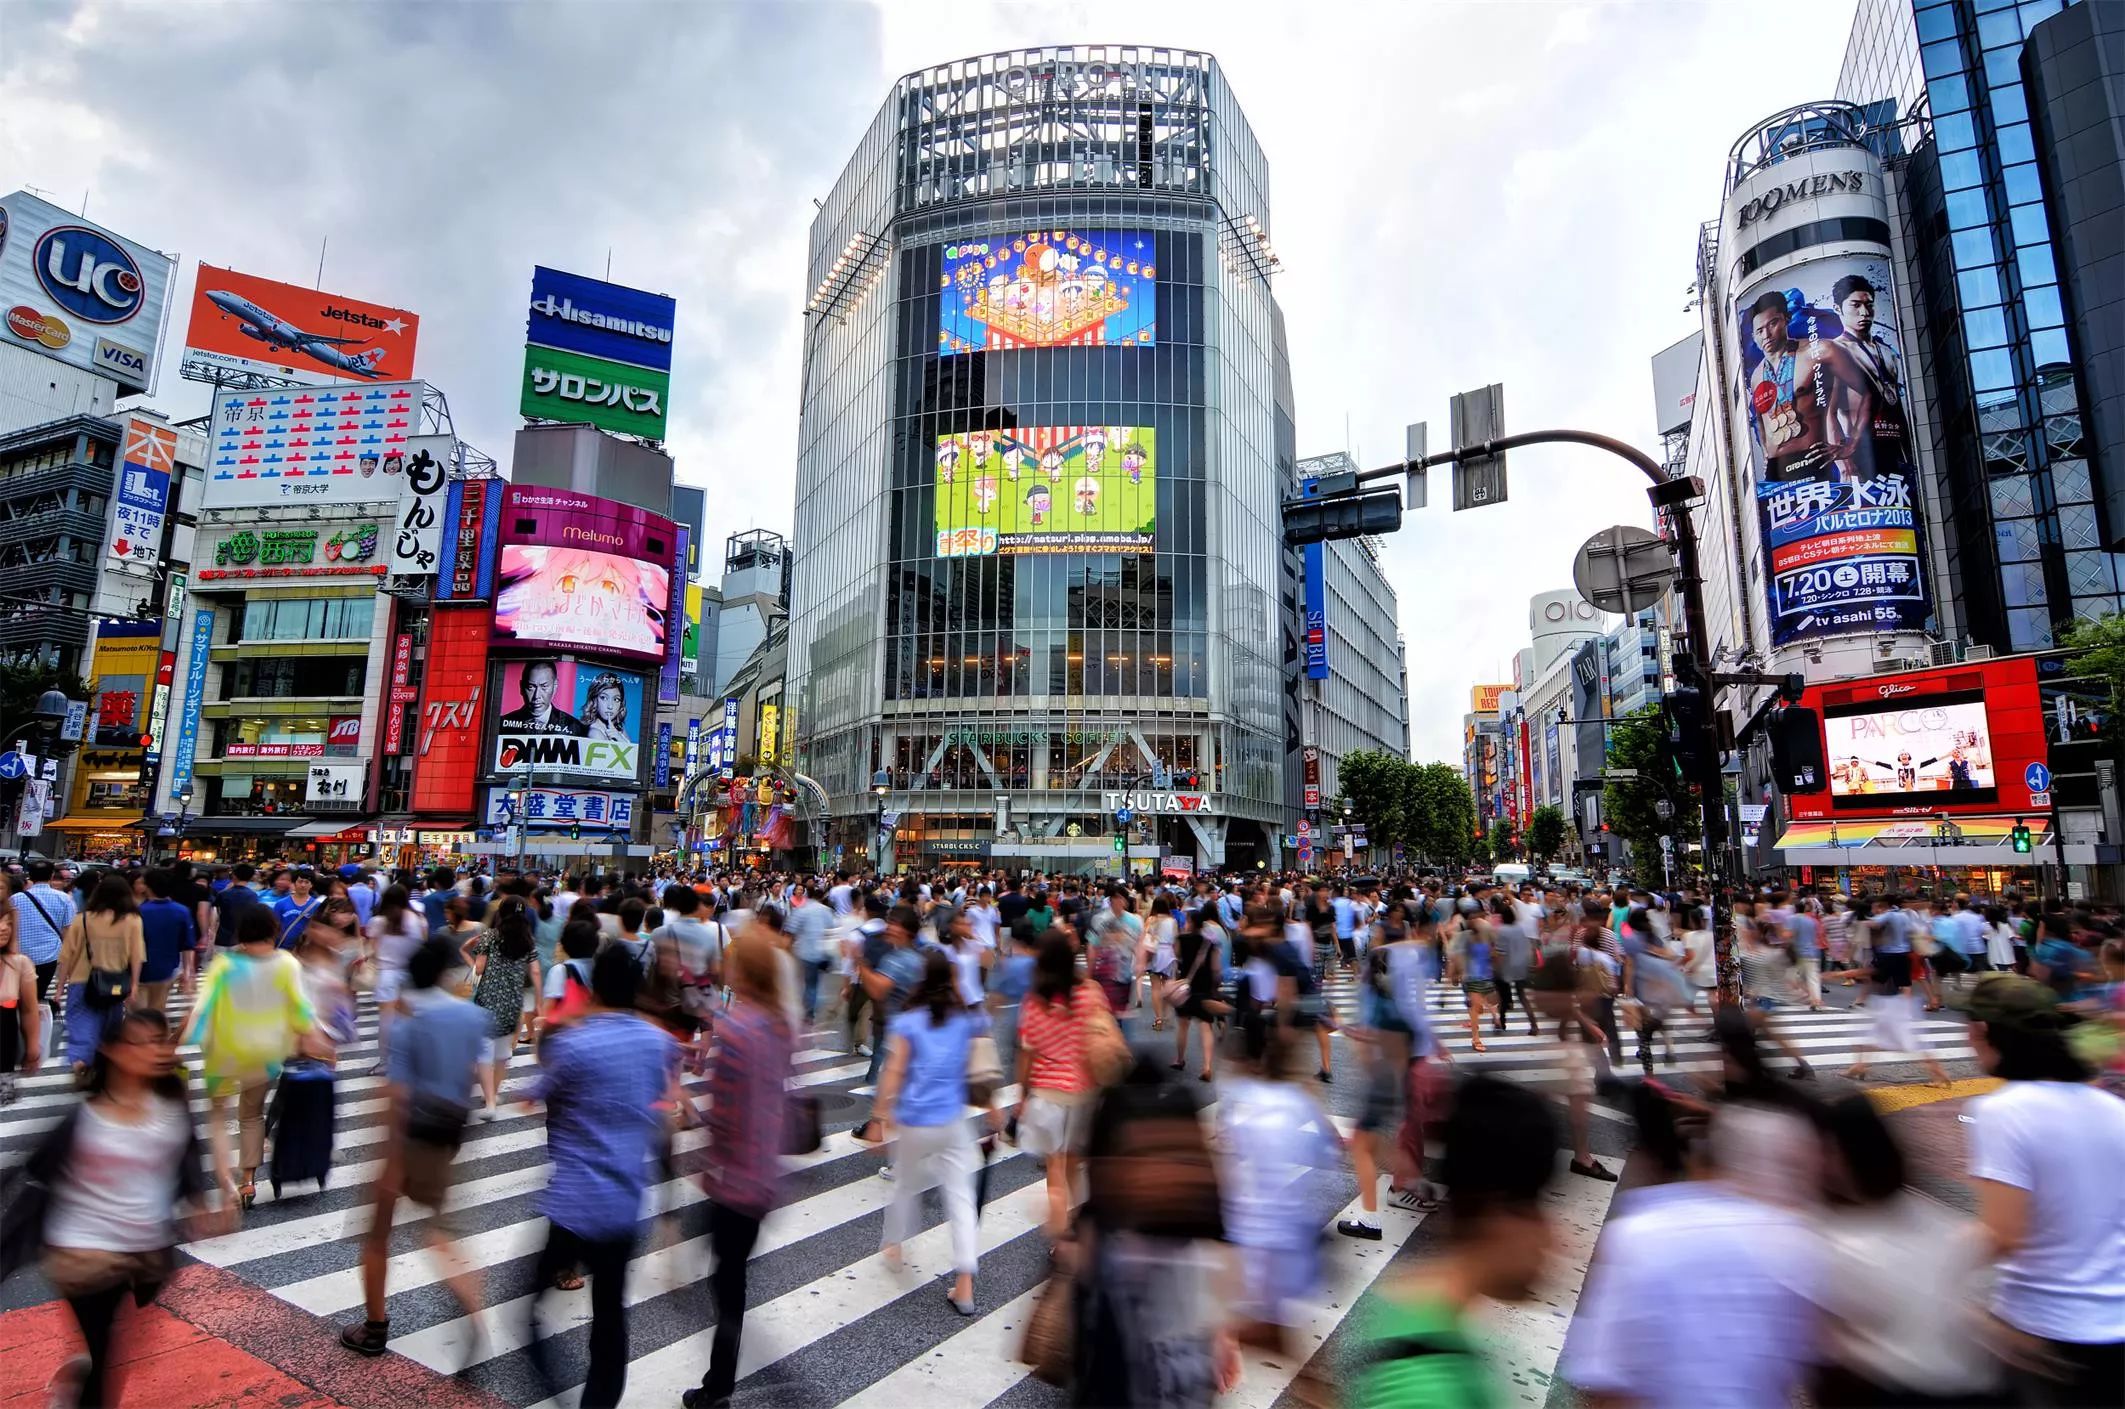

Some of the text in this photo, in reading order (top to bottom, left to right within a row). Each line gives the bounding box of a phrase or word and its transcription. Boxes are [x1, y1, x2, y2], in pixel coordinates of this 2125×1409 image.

[47, 238, 142, 308] UC
[242, 301, 276, 323] Jetstar
[320, 305, 387, 330] Jetstar
[531, 294, 672, 343] Hisamitsu
[9, 312, 69, 341] MasterCard
[102, 346, 144, 372] VISA
[192, 348, 238, 364] jetstar.com
[531, 366, 661, 416] サロンパス
[293, 484, 329, 495] 帝京大学
[395, 448, 446, 570] もんじゃ
[555, 498, 589, 508] チャンネル
[118, 506, 160, 528] 夜11時
[1815, 510, 1913, 533] バルセロナ2013
[123, 523, 151, 540] まで
[132, 544, 157, 561] 地下
[1815, 614, 1830, 627] tv
[1833, 610, 1872, 625] asahi
[1307, 611, 1324, 666] SEIBU
[185, 634, 208, 728] サマーフルーツギフト
[1878, 684, 1916, 698] Glico
[329, 718, 360, 738] JTB
[419, 685, 481, 756] クスリ
[723, 701, 736, 762] 洋服の青山
[1851, 708, 1949, 740] PARCO
[228, 746, 288, 754] 国内旅行 海外旅行
[501, 738, 633, 770] DMM FX
[496, 792, 631, 821] 大盛堂書店
[423, 834, 471, 843] 三千里薬品
